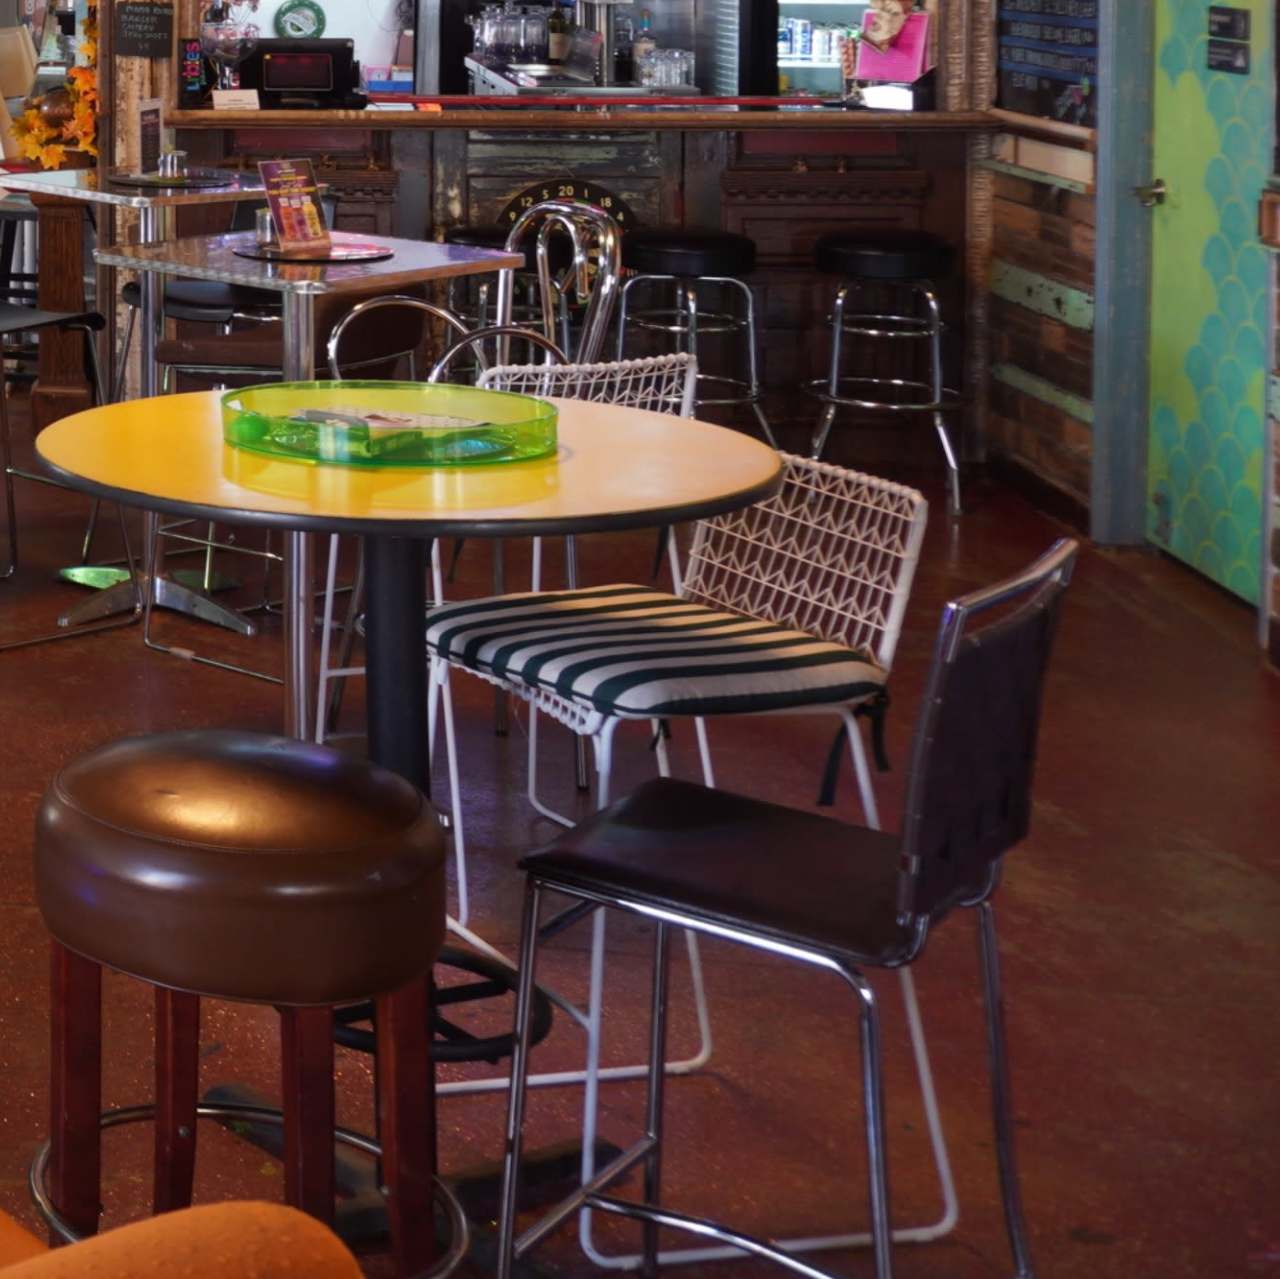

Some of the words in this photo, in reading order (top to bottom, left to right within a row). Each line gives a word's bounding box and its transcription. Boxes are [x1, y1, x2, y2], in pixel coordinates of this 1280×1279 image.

[542, 189, 549, 199] 5
[558, 185, 574, 196] 20
[521, 197, 533, 207] 12
[600, 197, 612, 207] 18
[509, 211, 516, 221] 9
[616, 211, 624, 221] 4
